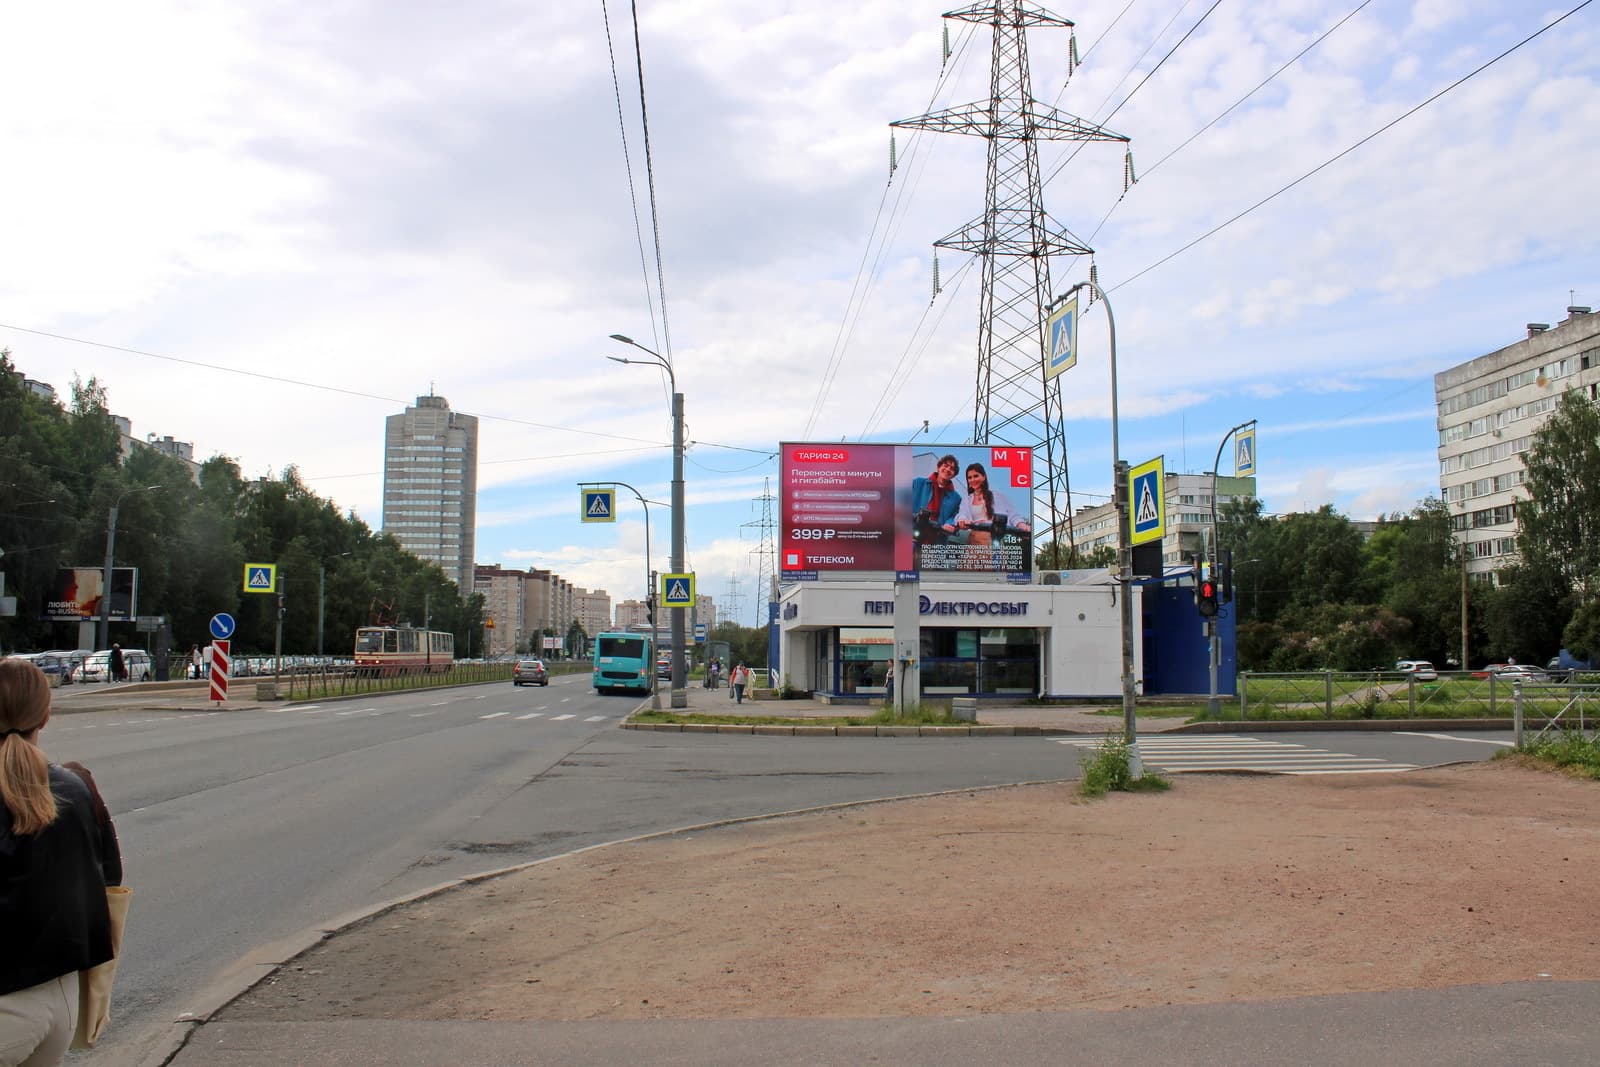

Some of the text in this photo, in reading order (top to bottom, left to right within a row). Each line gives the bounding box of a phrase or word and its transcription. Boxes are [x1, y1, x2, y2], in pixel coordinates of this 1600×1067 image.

[799, 452, 831, 460] ТАРИФ
[791, 469, 882, 479] Переносите минуты
[799, 477, 846, 485] гигабайты
[806, 556, 855, 564] ТЕЛЕКОМ
